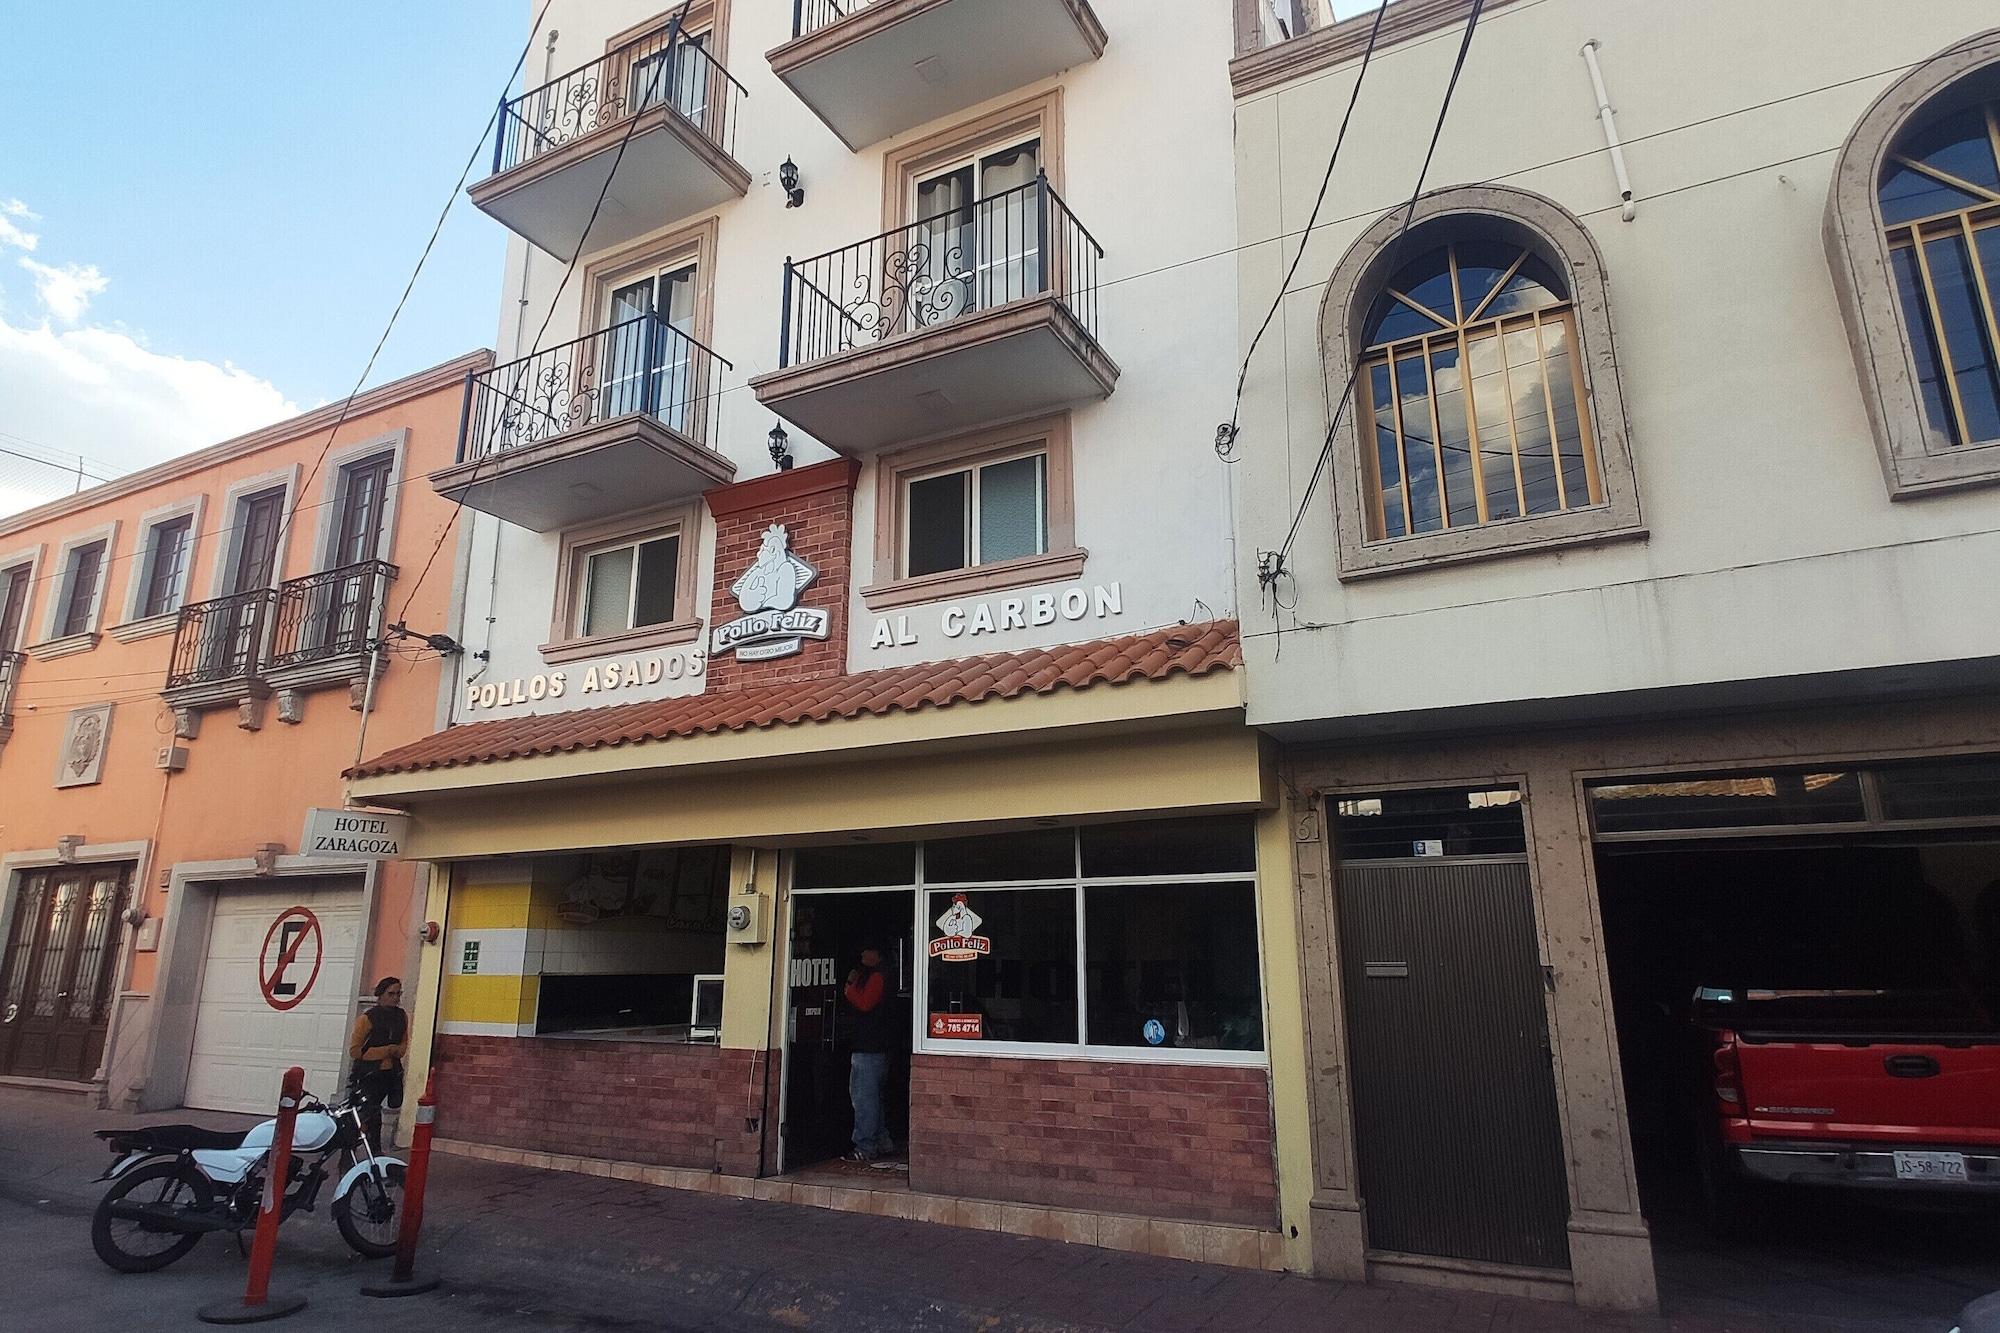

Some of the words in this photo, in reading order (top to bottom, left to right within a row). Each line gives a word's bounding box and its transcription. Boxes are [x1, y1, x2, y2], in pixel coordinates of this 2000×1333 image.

[870, 615, 918, 649] AL
[941, 582, 1122, 637] CARBON
[718, 617, 768, 645] Pollo
[770, 611, 822, 633] Feliz
[466, 671, 567, 710] POLLOS
[581, 649, 706, 693] ASADOS
[334, 817, 389, 834] HOTEL
[315, 836, 399, 854] ZARAGOZA
[933, 938, 960, 952] Pollo
[962, 937, 986, 950] Feliz
[790, 957, 837, 987] HOTEL
[962, 1023, 980, 1033] 4714
[1899, 1160, 1964, 1175] JS-58-722
